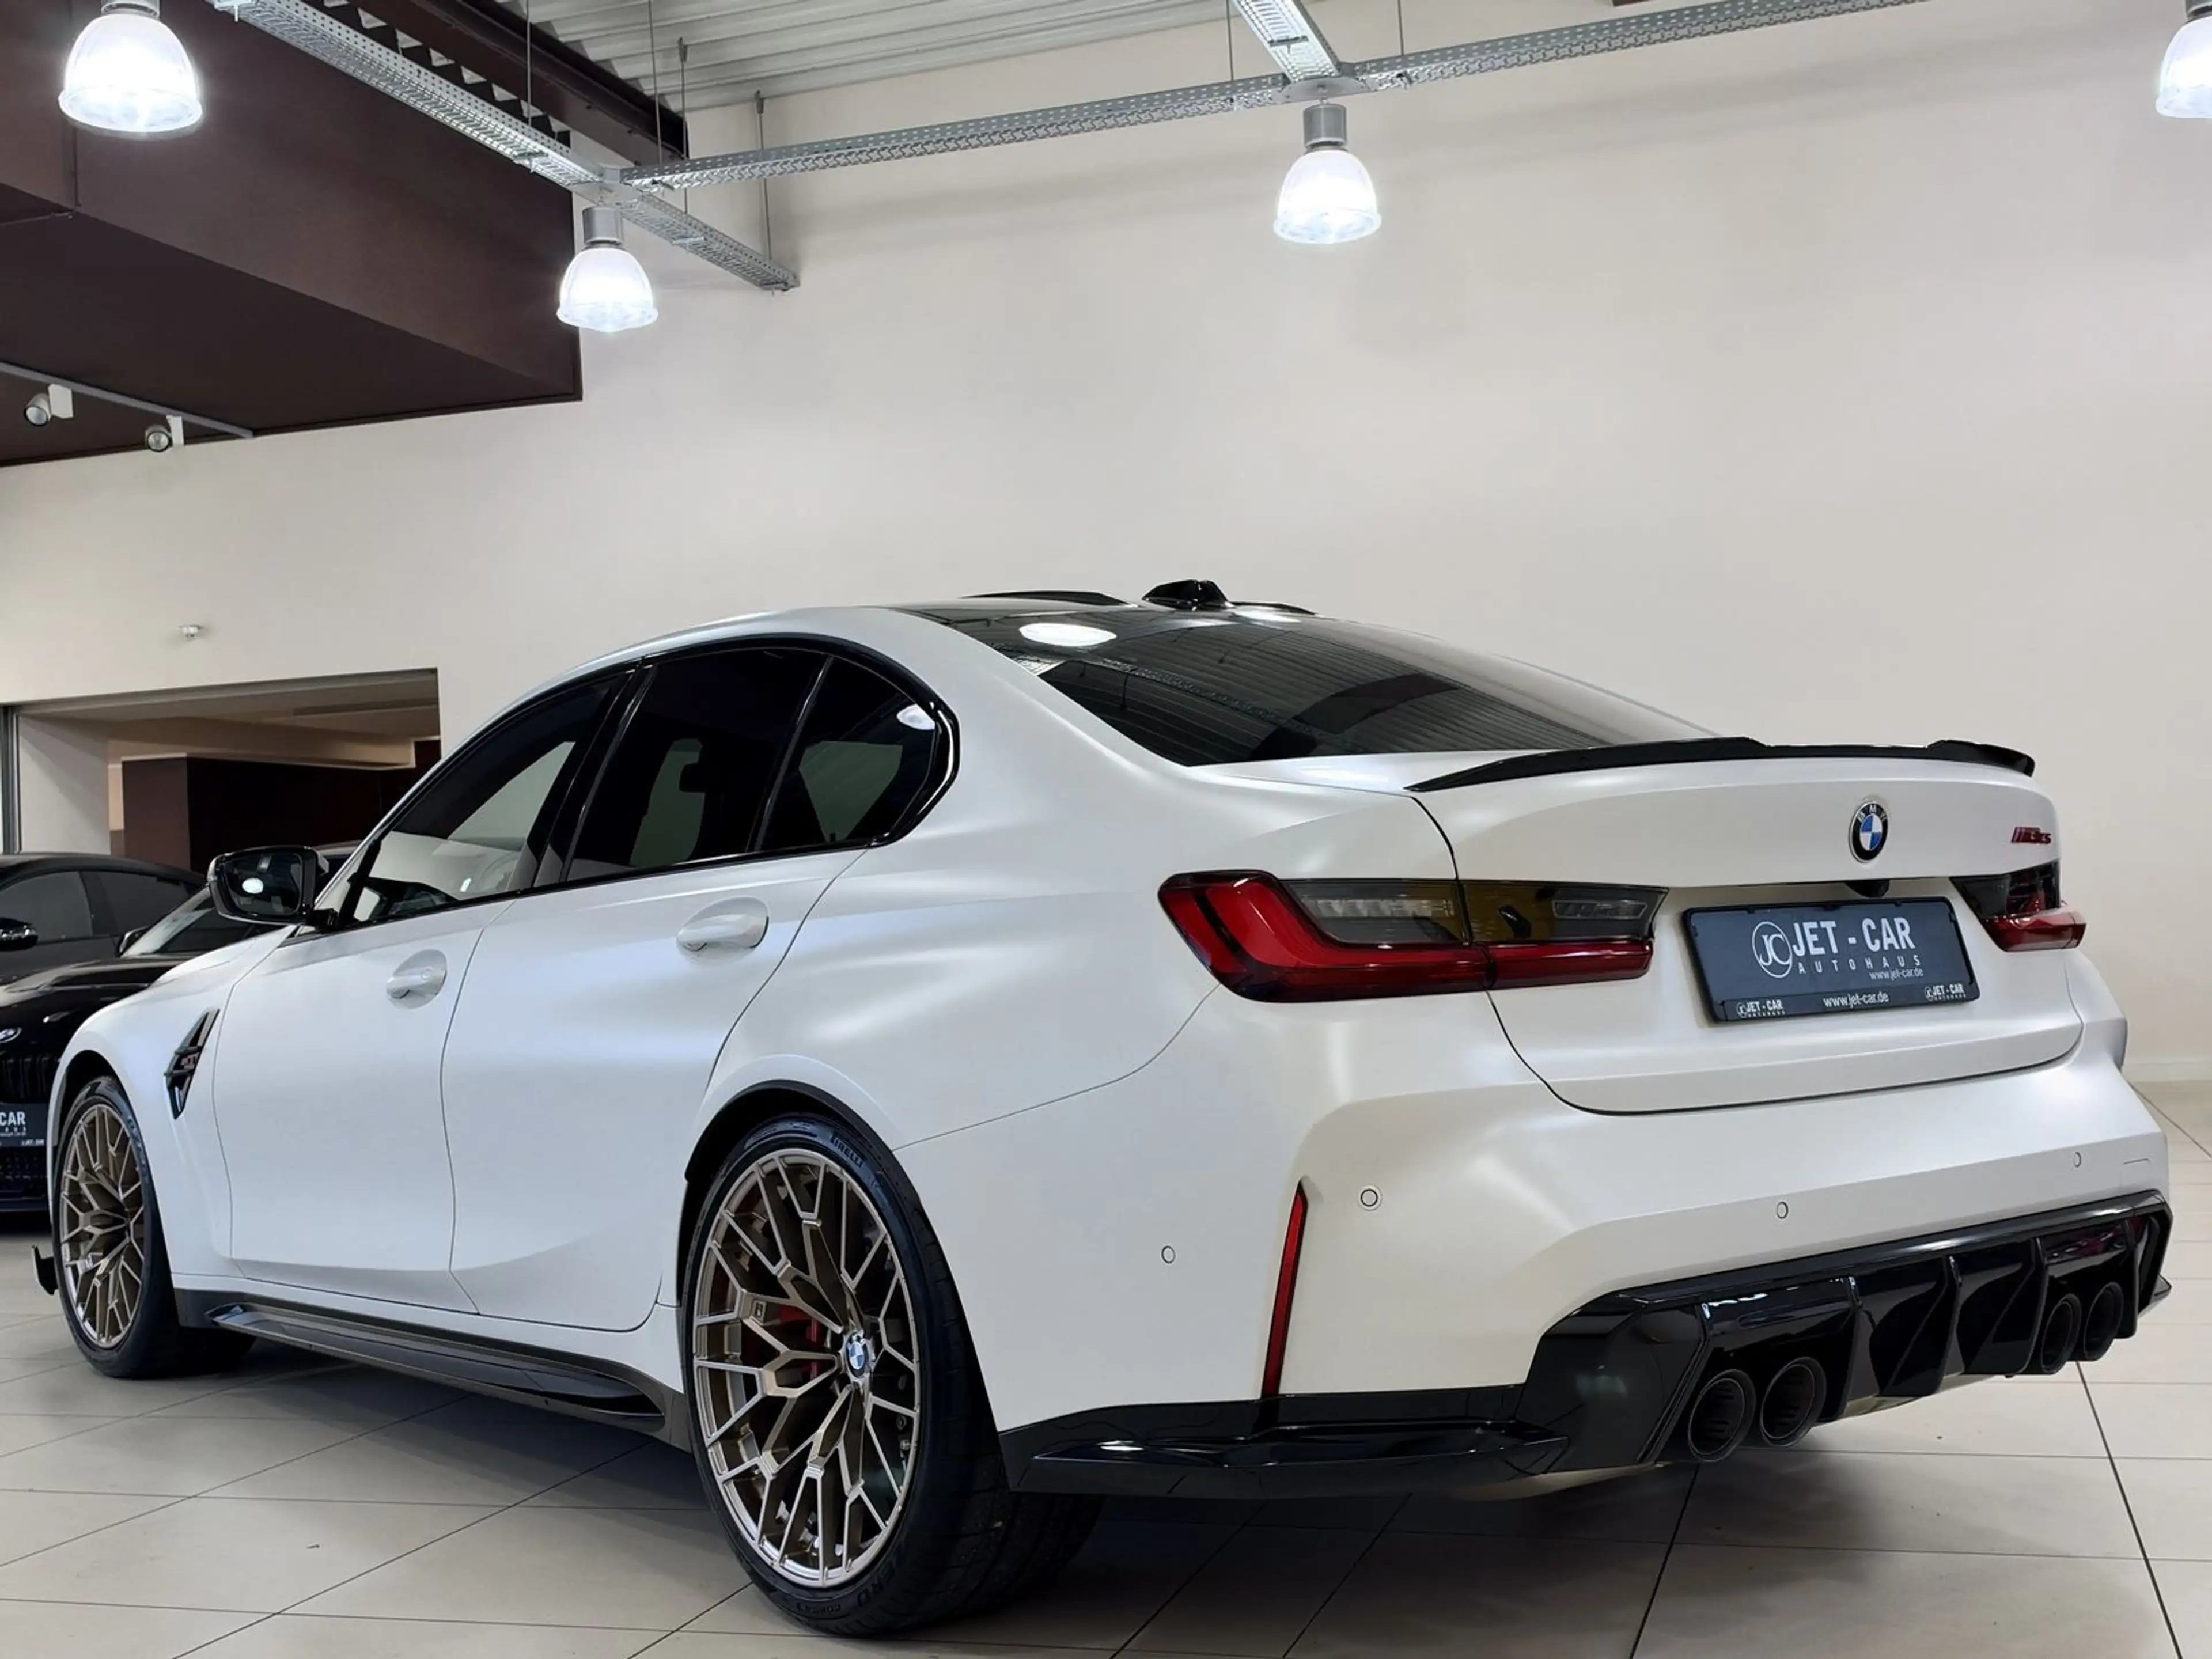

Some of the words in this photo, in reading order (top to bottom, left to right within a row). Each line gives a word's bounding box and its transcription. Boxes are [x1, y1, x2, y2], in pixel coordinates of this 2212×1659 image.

[1792, 921, 1838, 956] JET
[1862, 917, 1916, 952] CAR
[1797, 955, 1921, 975] AUTOHAUS
[1869, 967, 1924, 981] www.jet-car.de
[1823, 991, 1889, 1009] www.jet-car.de
[0, 1111, 26, 1126] CAR
